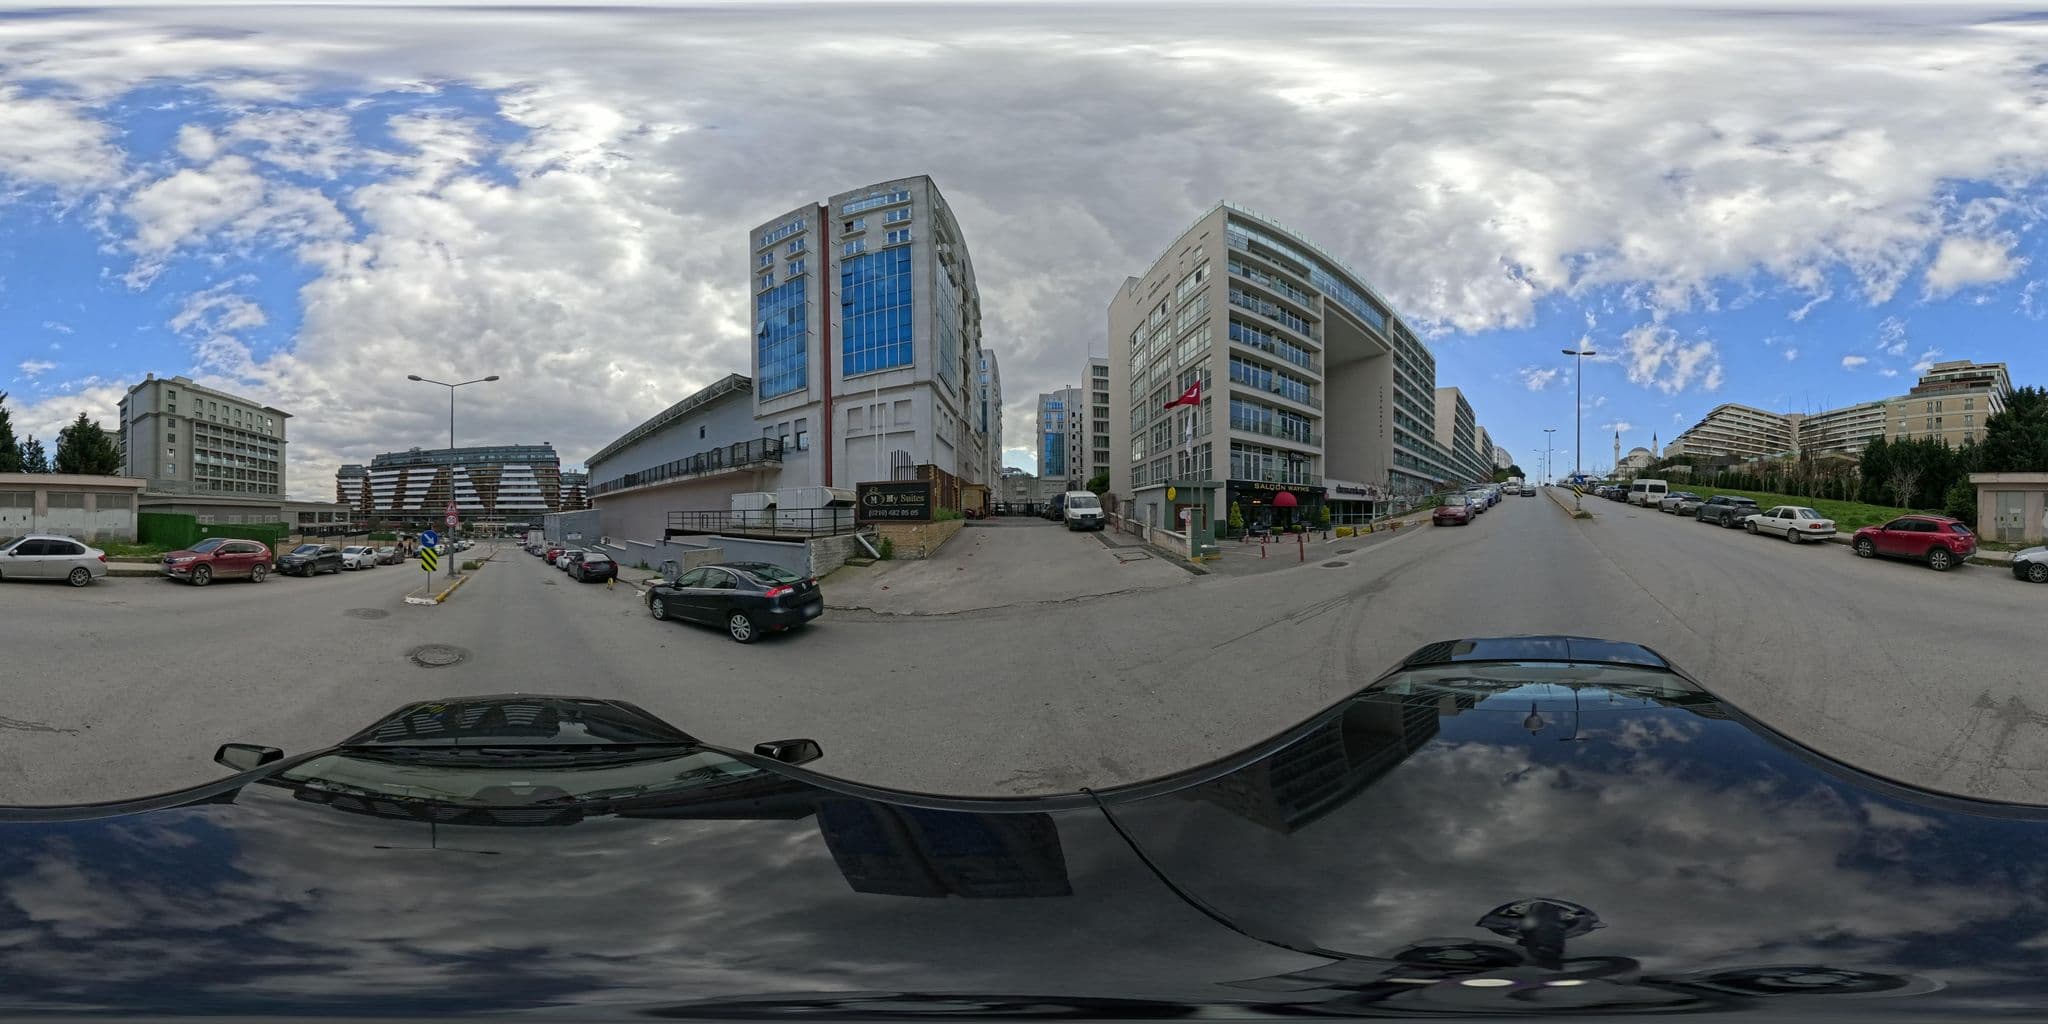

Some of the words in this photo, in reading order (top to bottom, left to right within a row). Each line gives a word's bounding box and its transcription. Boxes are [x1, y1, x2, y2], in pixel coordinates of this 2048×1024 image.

[1254, 482, 1286, 491] SALOON
[886, 494, 899, 505] My
[900, 494, 925, 503] Suites
